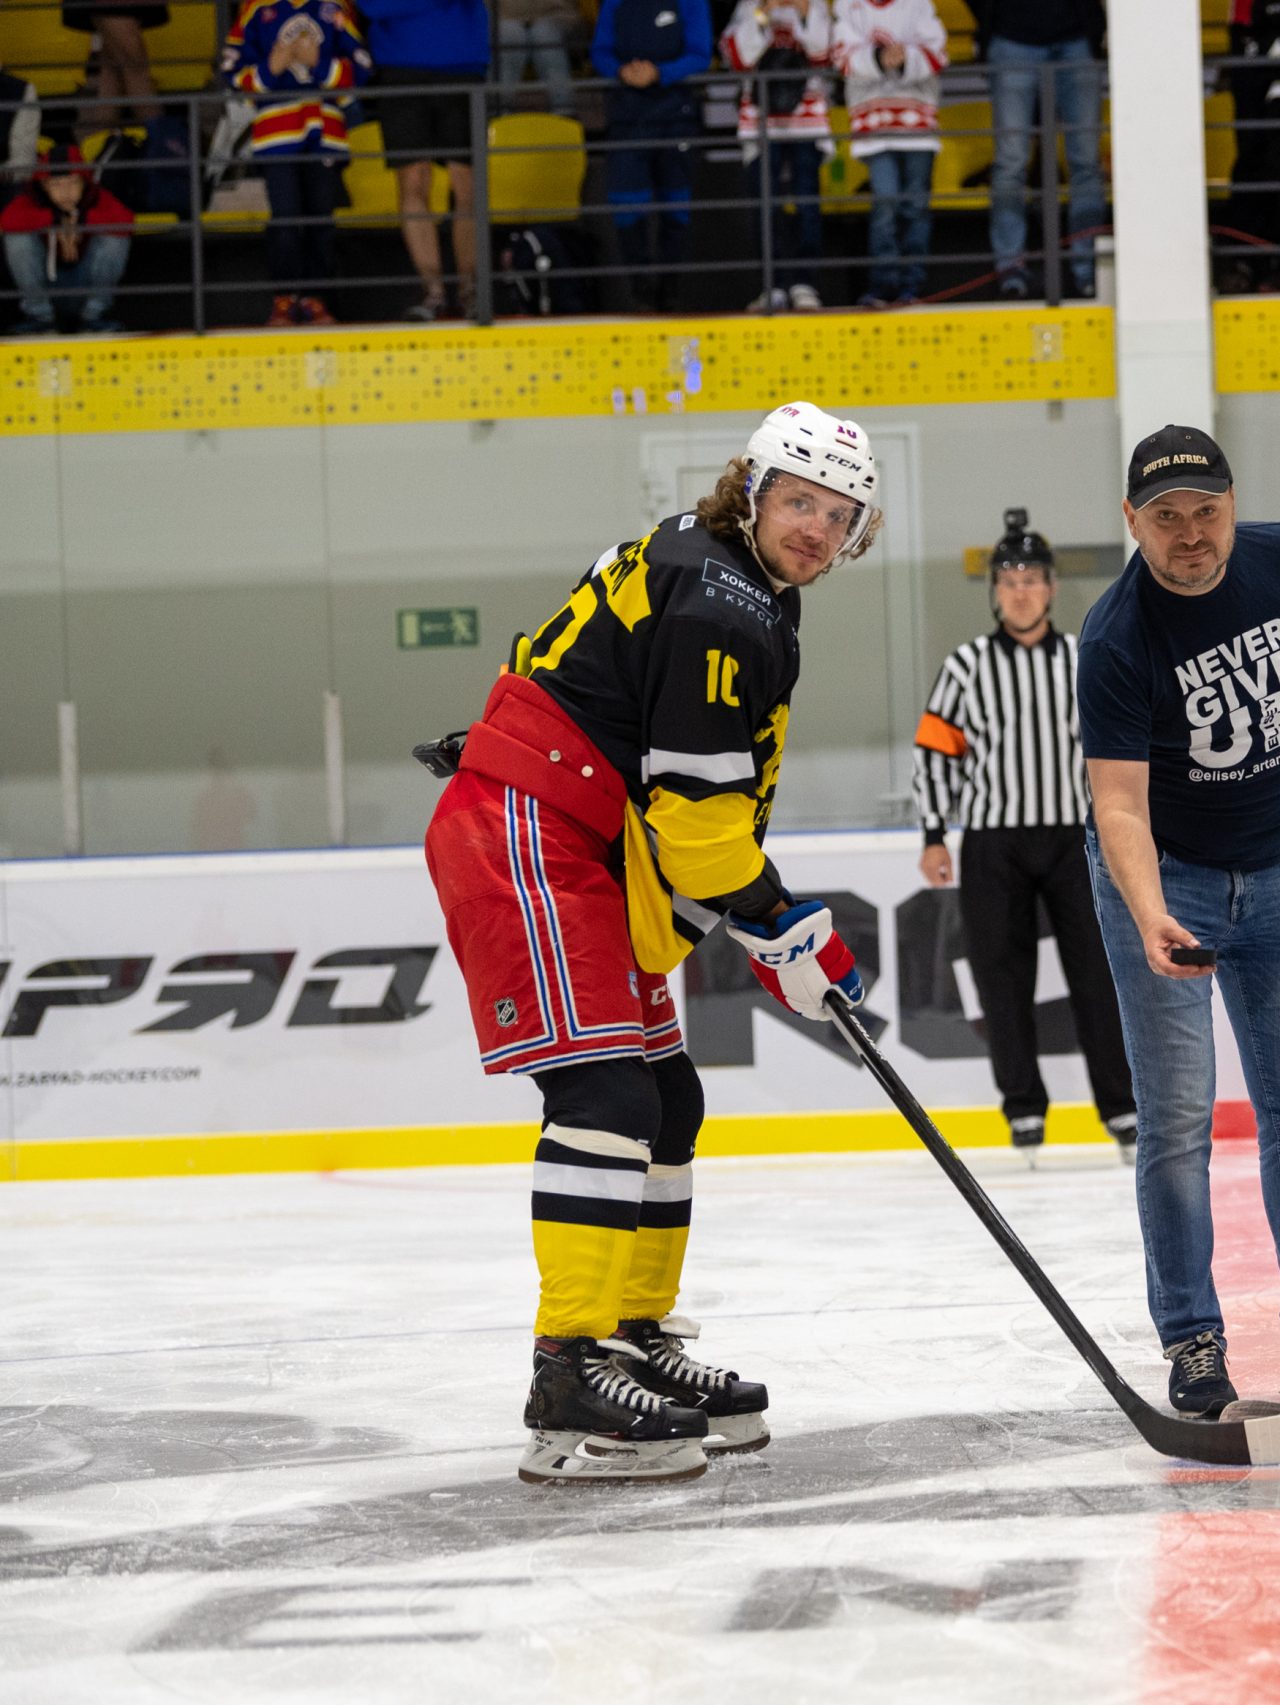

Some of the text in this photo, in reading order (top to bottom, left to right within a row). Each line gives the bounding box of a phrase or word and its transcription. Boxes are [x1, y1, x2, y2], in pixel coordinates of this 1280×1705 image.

[825, 453, 862, 472] CCM
[1143, 454, 1209, 477] SOUTH AFRICA
[720, 570, 772, 606] ХОККЕЙ
[705, 587, 774, 630] В КУРСЕ
[750, 932, 815, 965] CM
